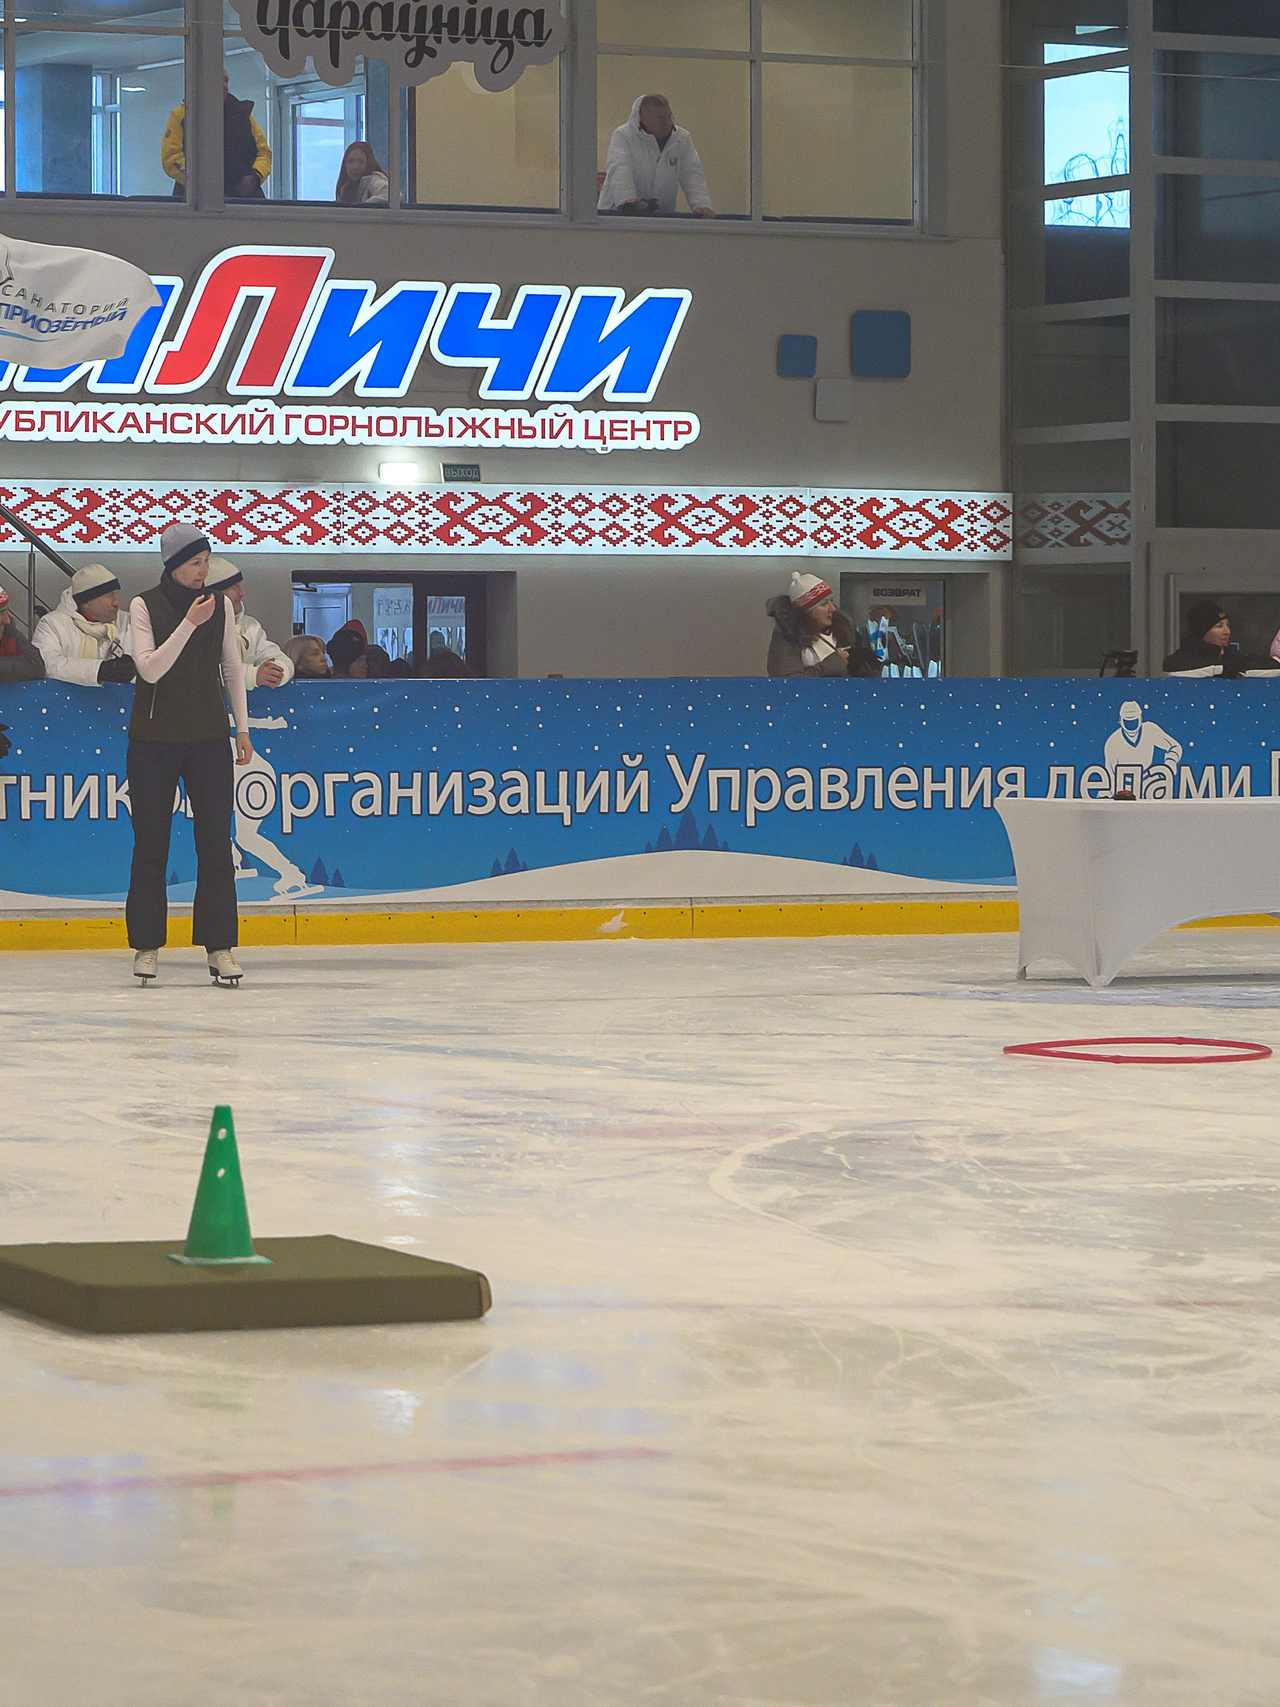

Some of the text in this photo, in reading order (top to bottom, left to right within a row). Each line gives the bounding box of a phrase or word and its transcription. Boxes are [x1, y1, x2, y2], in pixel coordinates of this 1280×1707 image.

[1, 284, 129, 316] САНАТОРИЙ
[284, 412, 574, 440] ГОРНОЛЫЖНЫЙ
[584, 418, 693, 445] ЦЕНТР
[444, 467, 480, 478] ВЫХОД
[872, 588, 922, 598] ВОЗВРАТ
[235, 753, 650, 834] организаций
[669, 753, 1026, 827] Управления
